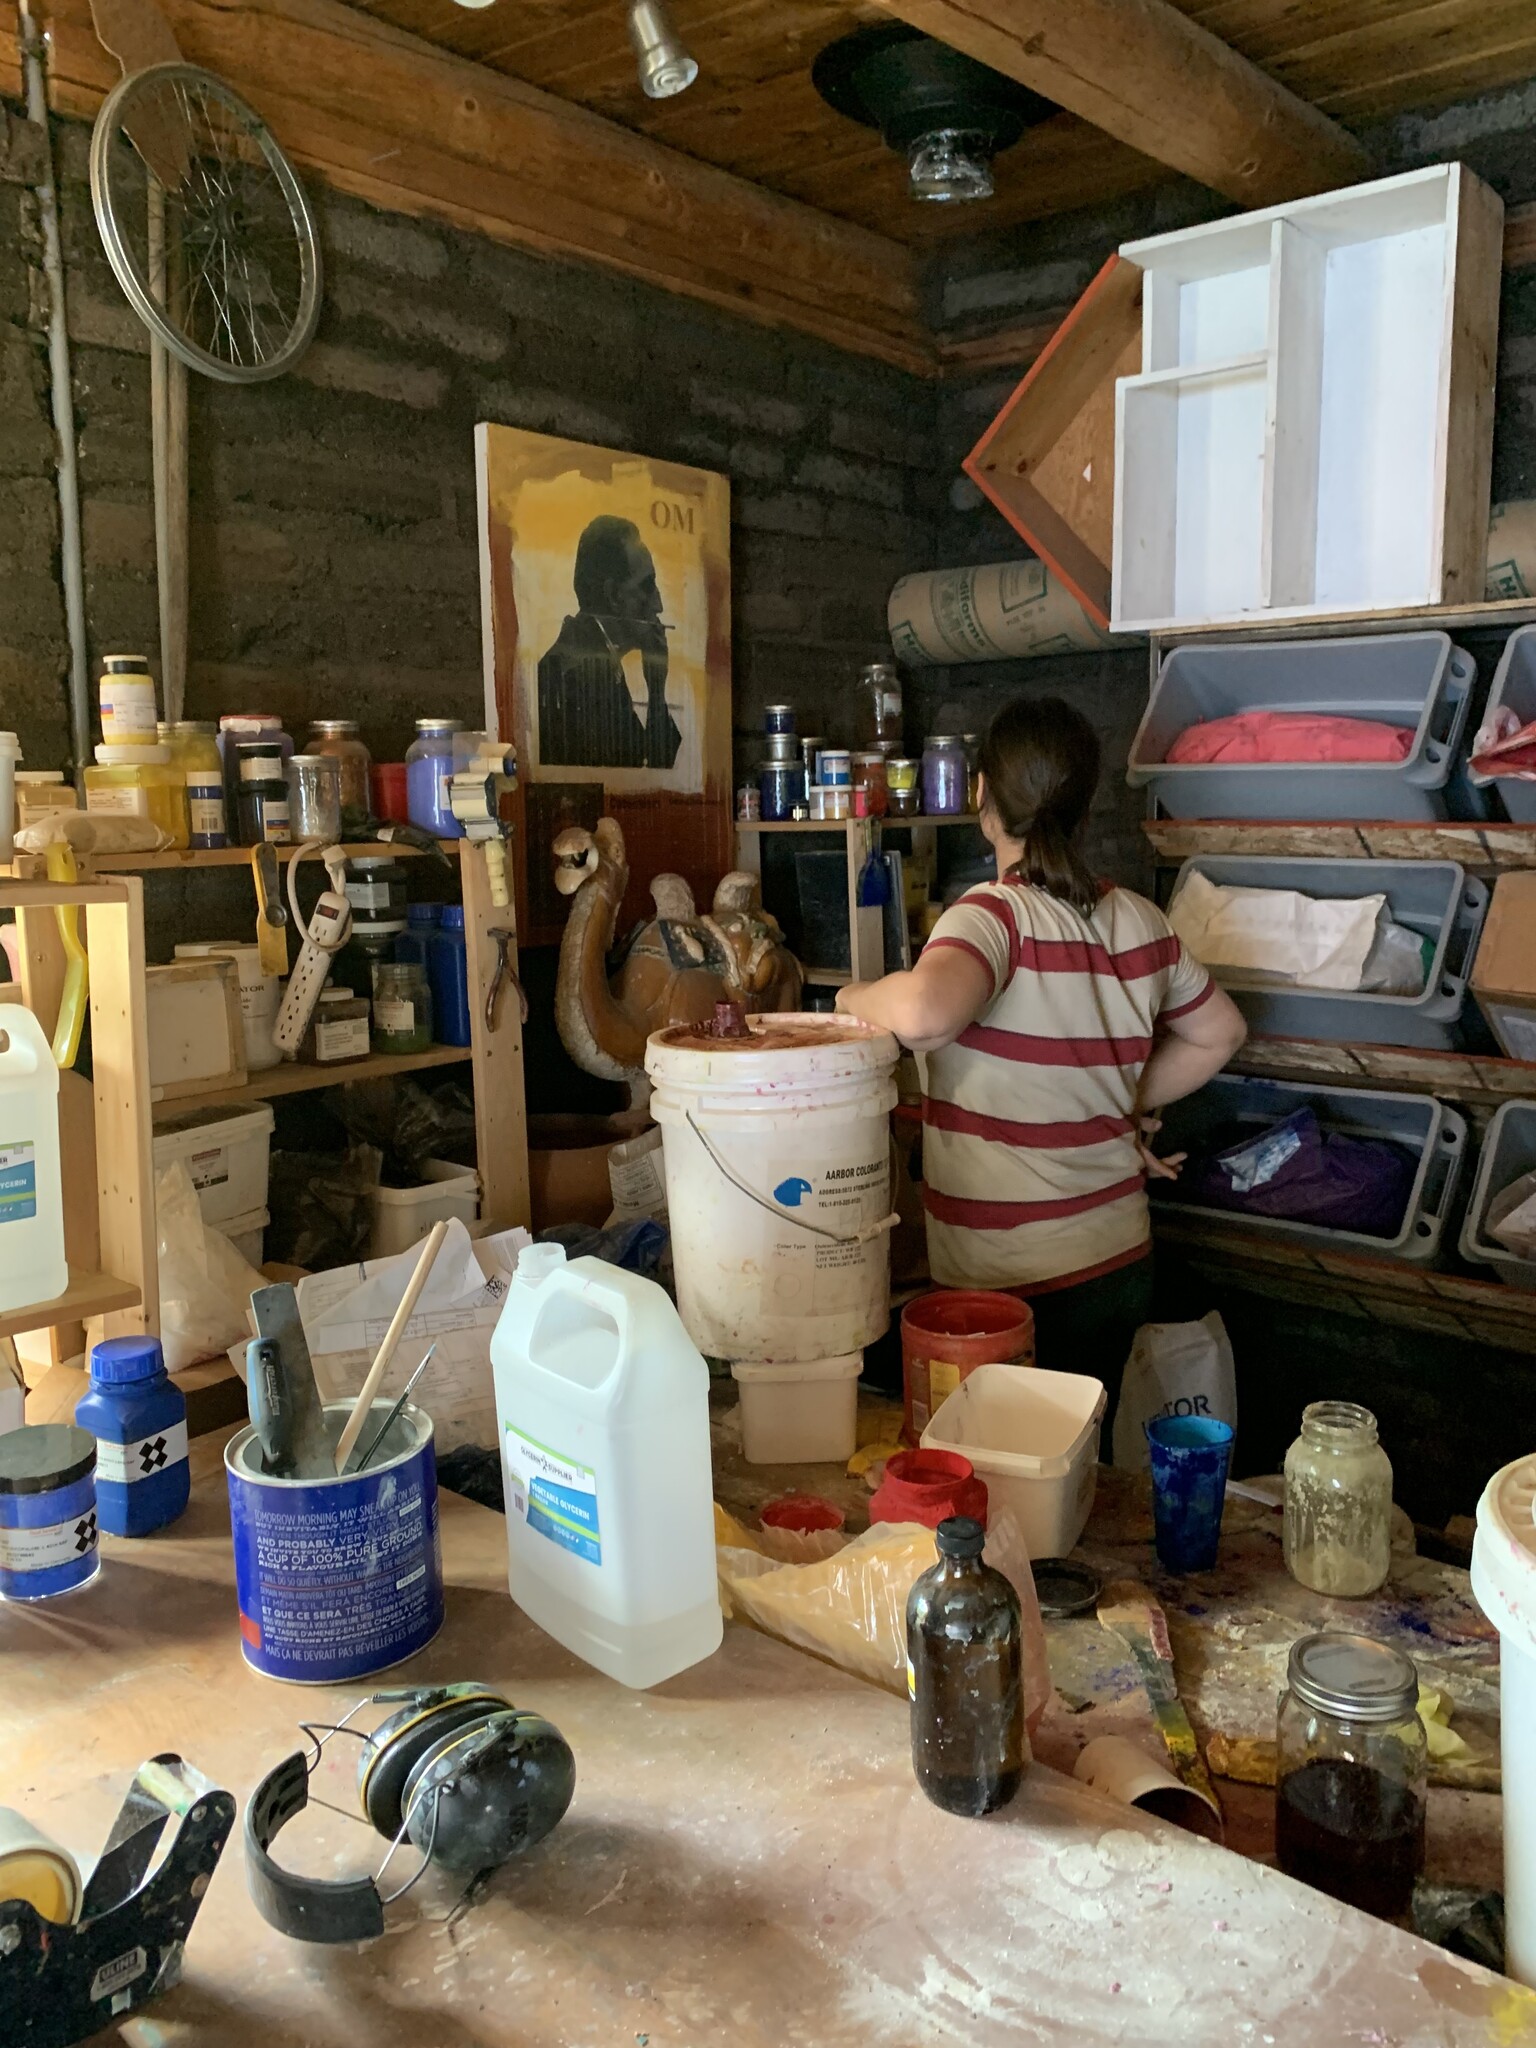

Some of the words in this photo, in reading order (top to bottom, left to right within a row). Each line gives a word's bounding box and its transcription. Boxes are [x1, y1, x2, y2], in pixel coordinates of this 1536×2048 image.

[651, 501, 695, 535] OM
[826, 1167, 855, 1181] AARBOR
[520, 1446, 541, 1466] GLYCERIN
[547, 1463, 573, 1481] SUPPLIER
[254, 1509, 296, 1526] TOMORROW
[297, 1511, 338, 1526] MORNING
[340, 1507, 358, 1522] MAY
[560, 1499, 590, 1521] GLYCERIN
[255, 1522, 273, 1530] BUT
[293, 1531, 329, 1540] THOUGH
[256, 1536, 276, 1547] AND
[278, 1537, 336, 1550] PROBABLY
[257, 1550, 265, 1561] A
[266, 1552, 289, 1564] CUP
[291, 1553, 309, 1567] OF
[311, 1551, 343, 1564] 100%
[346, 1545, 379, 1560] PURE
[258, 1559, 280, 1570] RICH
[291, 1557, 367, 1572] FLAVOURFUL
[277, 1576, 286, 1586] DO
[287, 1577, 296, 1587] SO
[323, 1571, 355, 1586] WITHOUT
[322, 1596, 351, 1610] FERA
[353, 1583, 395, 1605] ENCORE
[336, 1587, 347, 1599] OU
[262, 1605, 272, 1617] ET
[273, 1609, 294, 1620] QUE
[296, 1611, 310, 1621] CE
[313, 1609, 342, 1621] SERA
[263, 1624, 276, 1635] UNE
[277, 1627, 299, 1638] TASSE
[356, 1620, 373, 1631] DES
[374, 1608, 403, 1626] CHOSES
[265, 1643, 281, 1658] MAIS
[292, 1649, 304, 1661] NE
[303, 1648, 337, 1662] DEVRAIT
[338, 1645, 354, 1659] PAS
[394, 1626, 407, 1643] LES
[99, 1951, 138, 1981] ULINE
